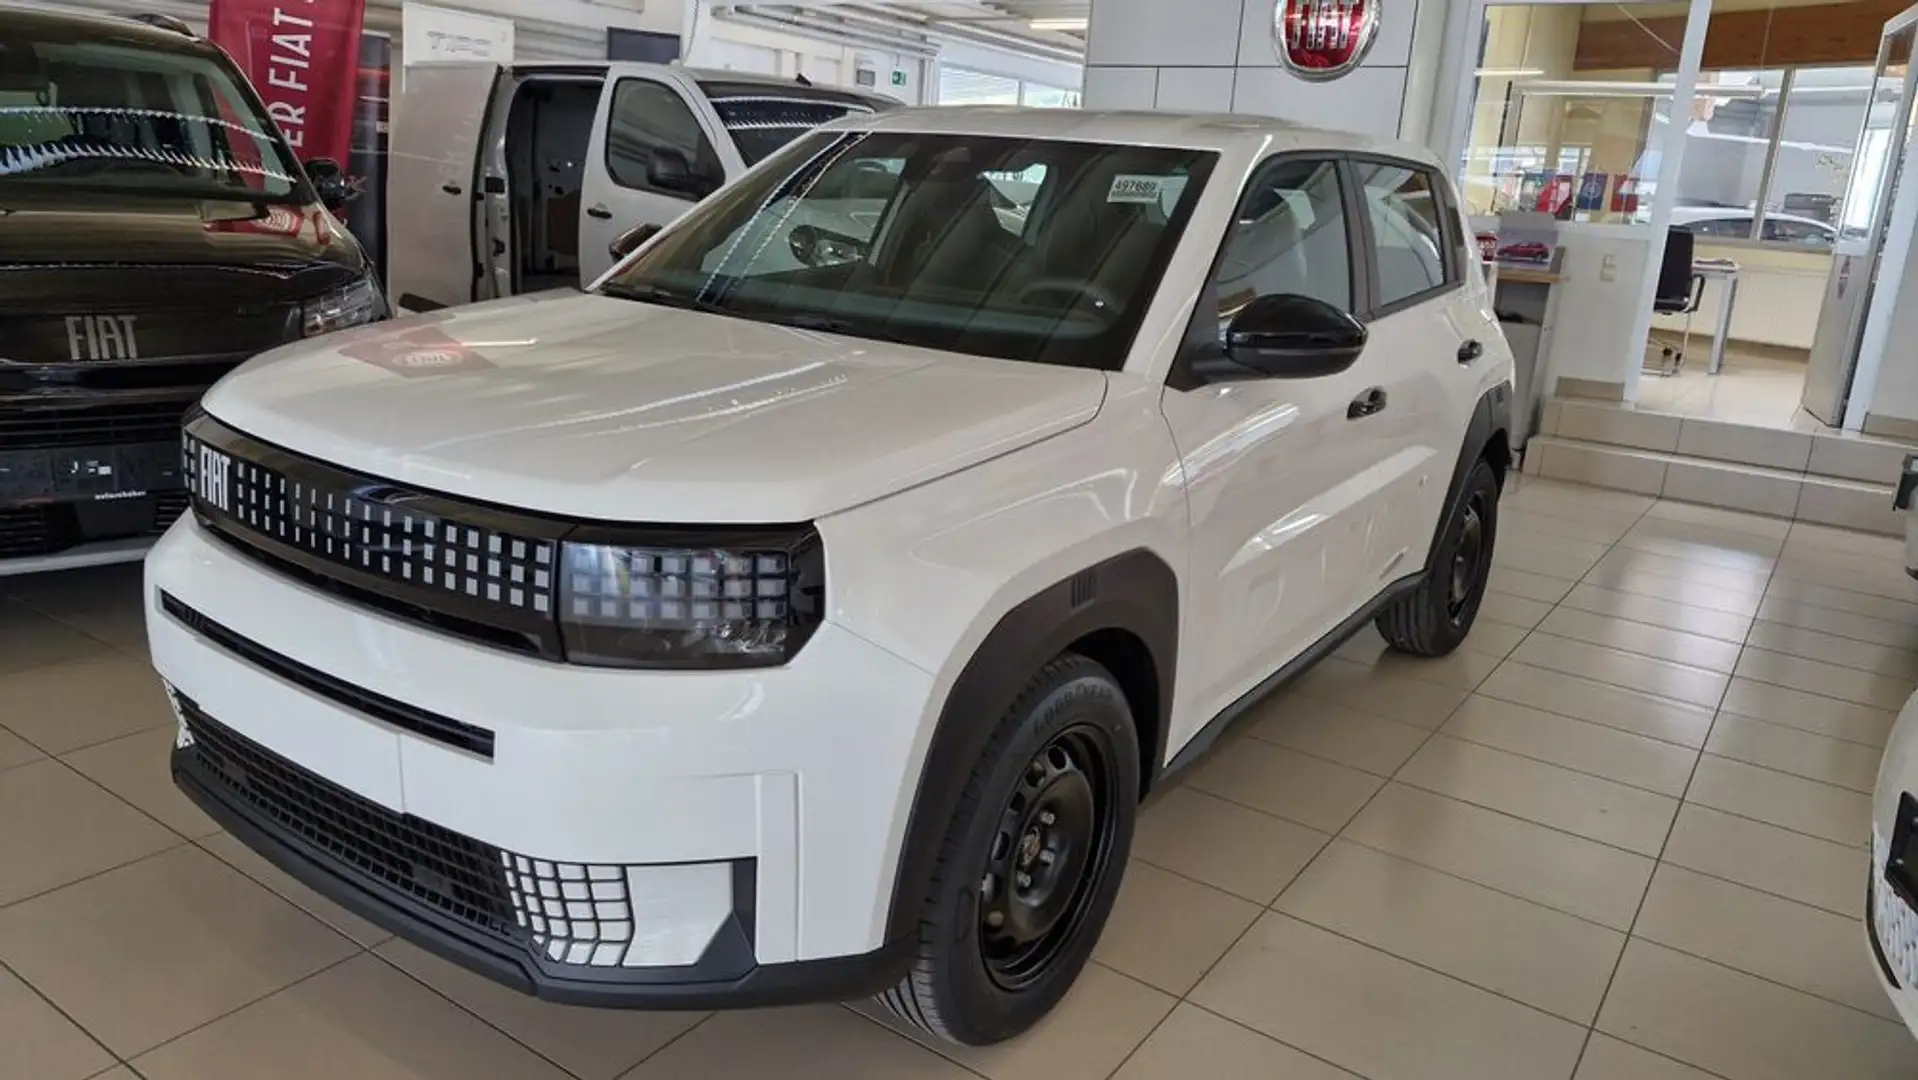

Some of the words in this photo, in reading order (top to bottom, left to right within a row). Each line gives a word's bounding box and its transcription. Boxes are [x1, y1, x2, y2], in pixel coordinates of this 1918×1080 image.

[268, 7, 314, 92] FIAT
[1290, 0, 1357, 50] FIAT
[65, 315, 138, 361] FIAT
[200, 445, 231, 512] FIAT
